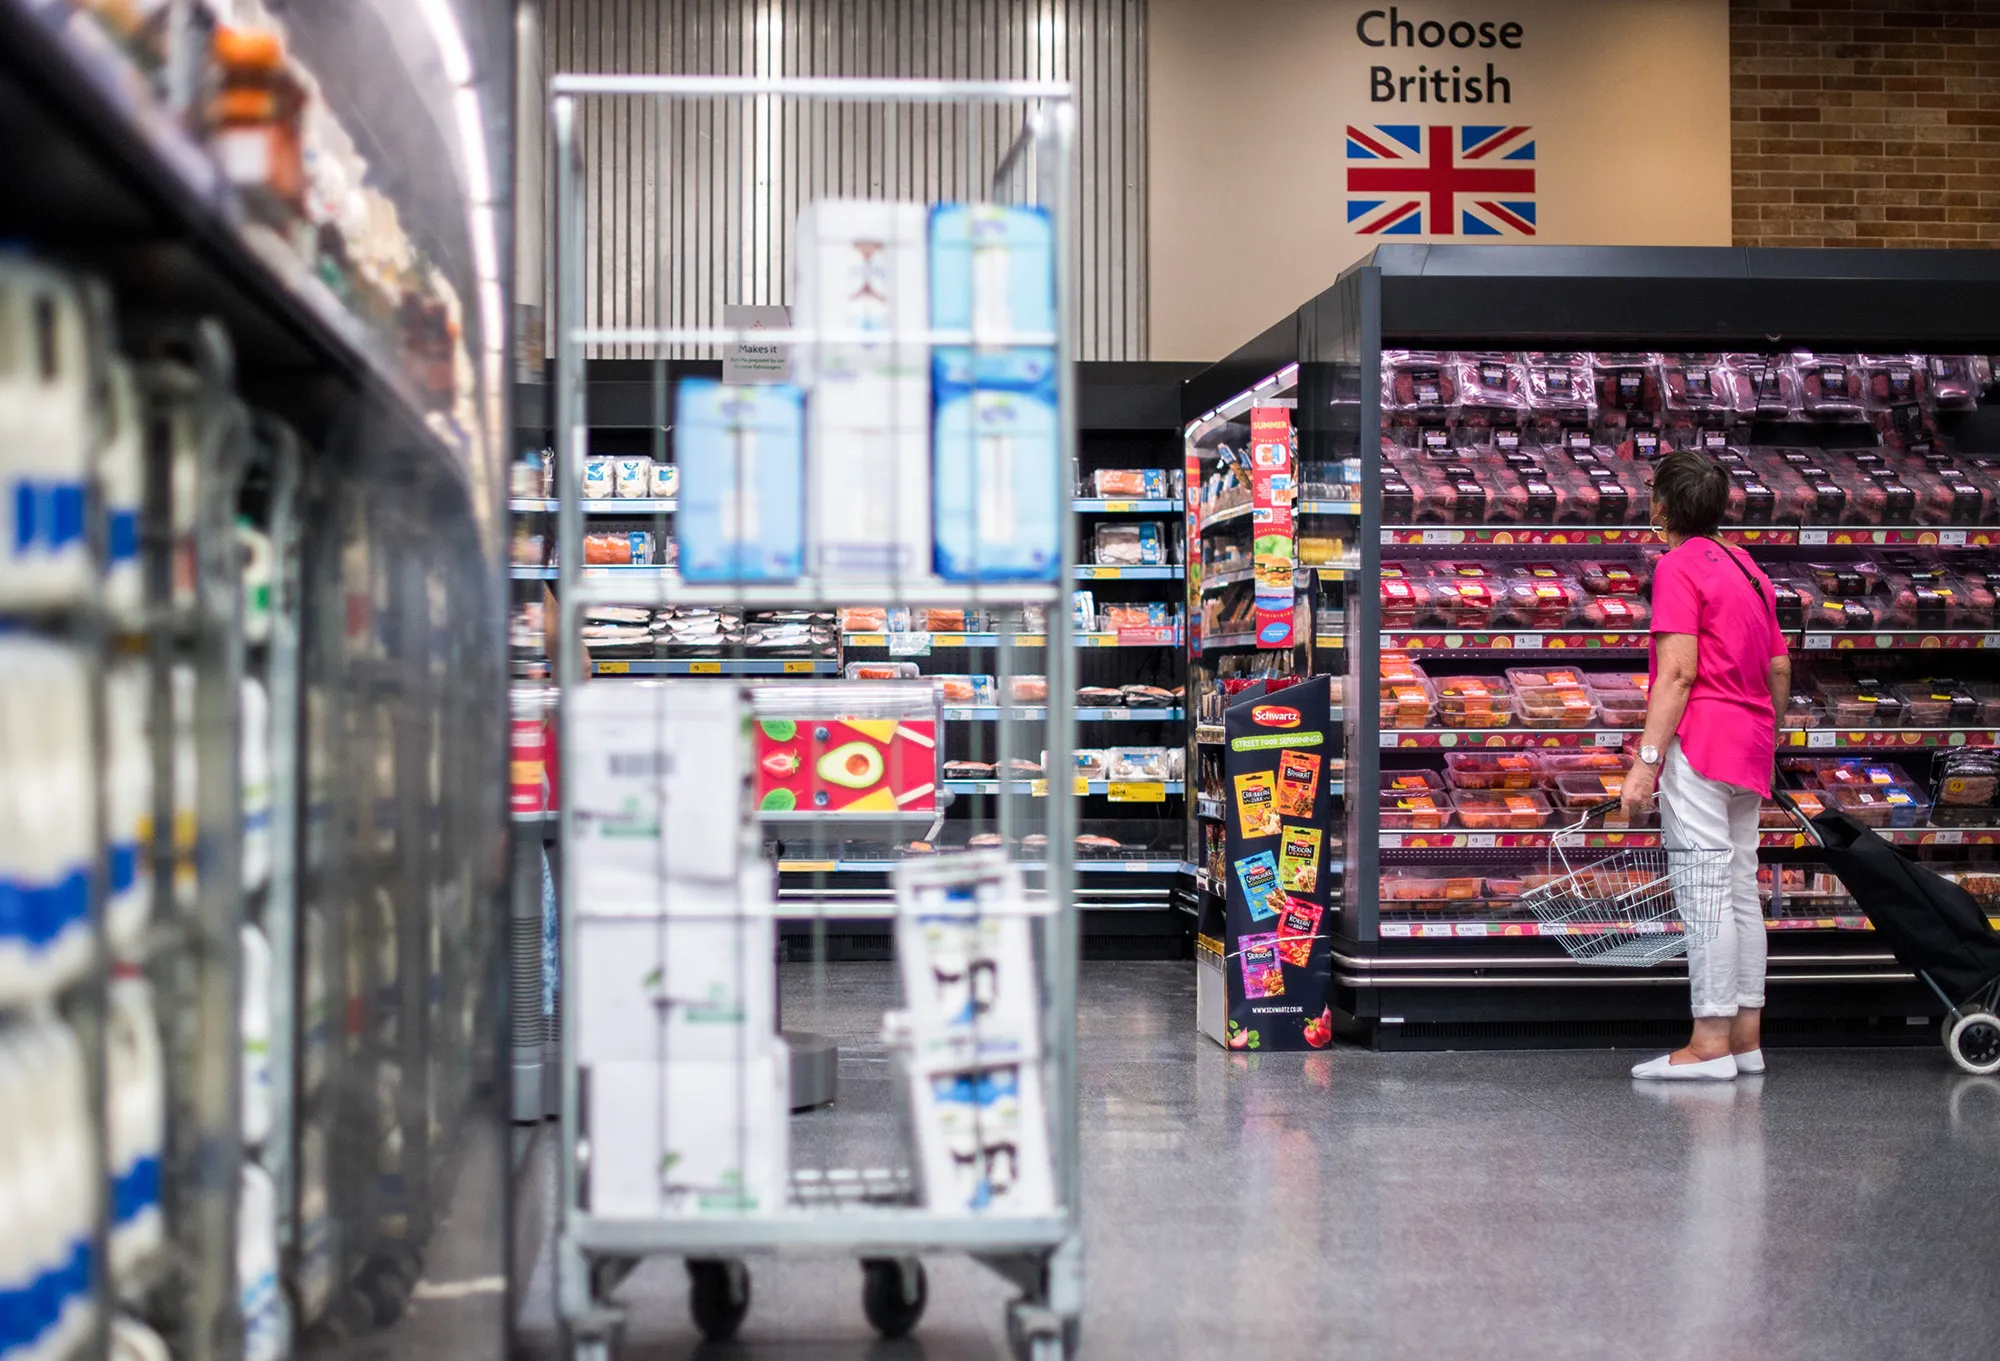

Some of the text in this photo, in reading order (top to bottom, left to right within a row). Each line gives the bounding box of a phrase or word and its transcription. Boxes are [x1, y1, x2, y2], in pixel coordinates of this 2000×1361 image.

[1356, 6, 1523, 49] Choose
[1370, 63, 1511, 104] British
[738, 344, 778, 353] Makes it
[1252, 421, 1287, 430] SUMMER
[1255, 711, 1297, 721] Schwartz
[1234, 735, 1321, 748] STREET FOOD SEASONINGS
[1242, 788, 1270, 799] CARIBBEAN
[1288, 845, 1312, 854] MEXICAN
[1289, 914, 1311, 926] KOREAN
